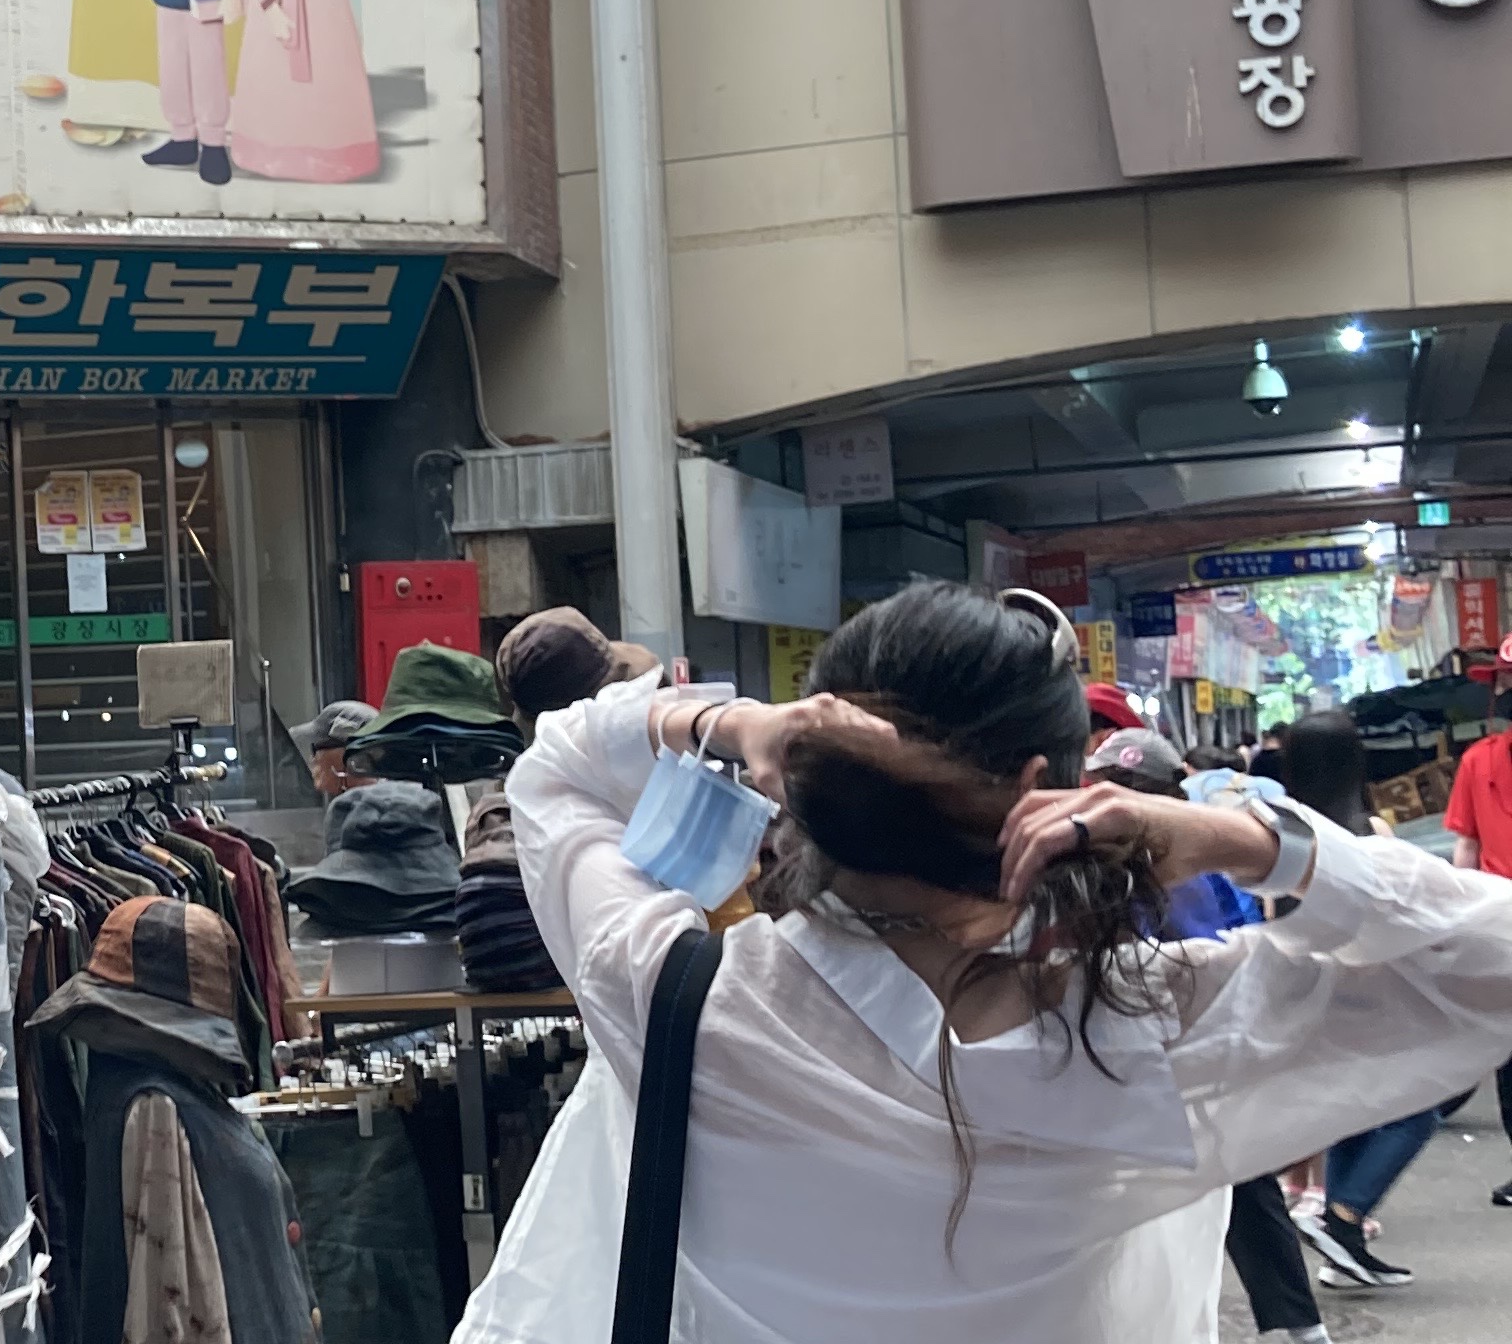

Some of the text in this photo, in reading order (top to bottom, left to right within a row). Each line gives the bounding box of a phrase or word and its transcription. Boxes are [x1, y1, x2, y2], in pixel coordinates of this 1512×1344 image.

[77, 366, 150, 393] BOK
[165, 366, 317, 393] MARKET
[50, 617, 152, 642] 광장시장
